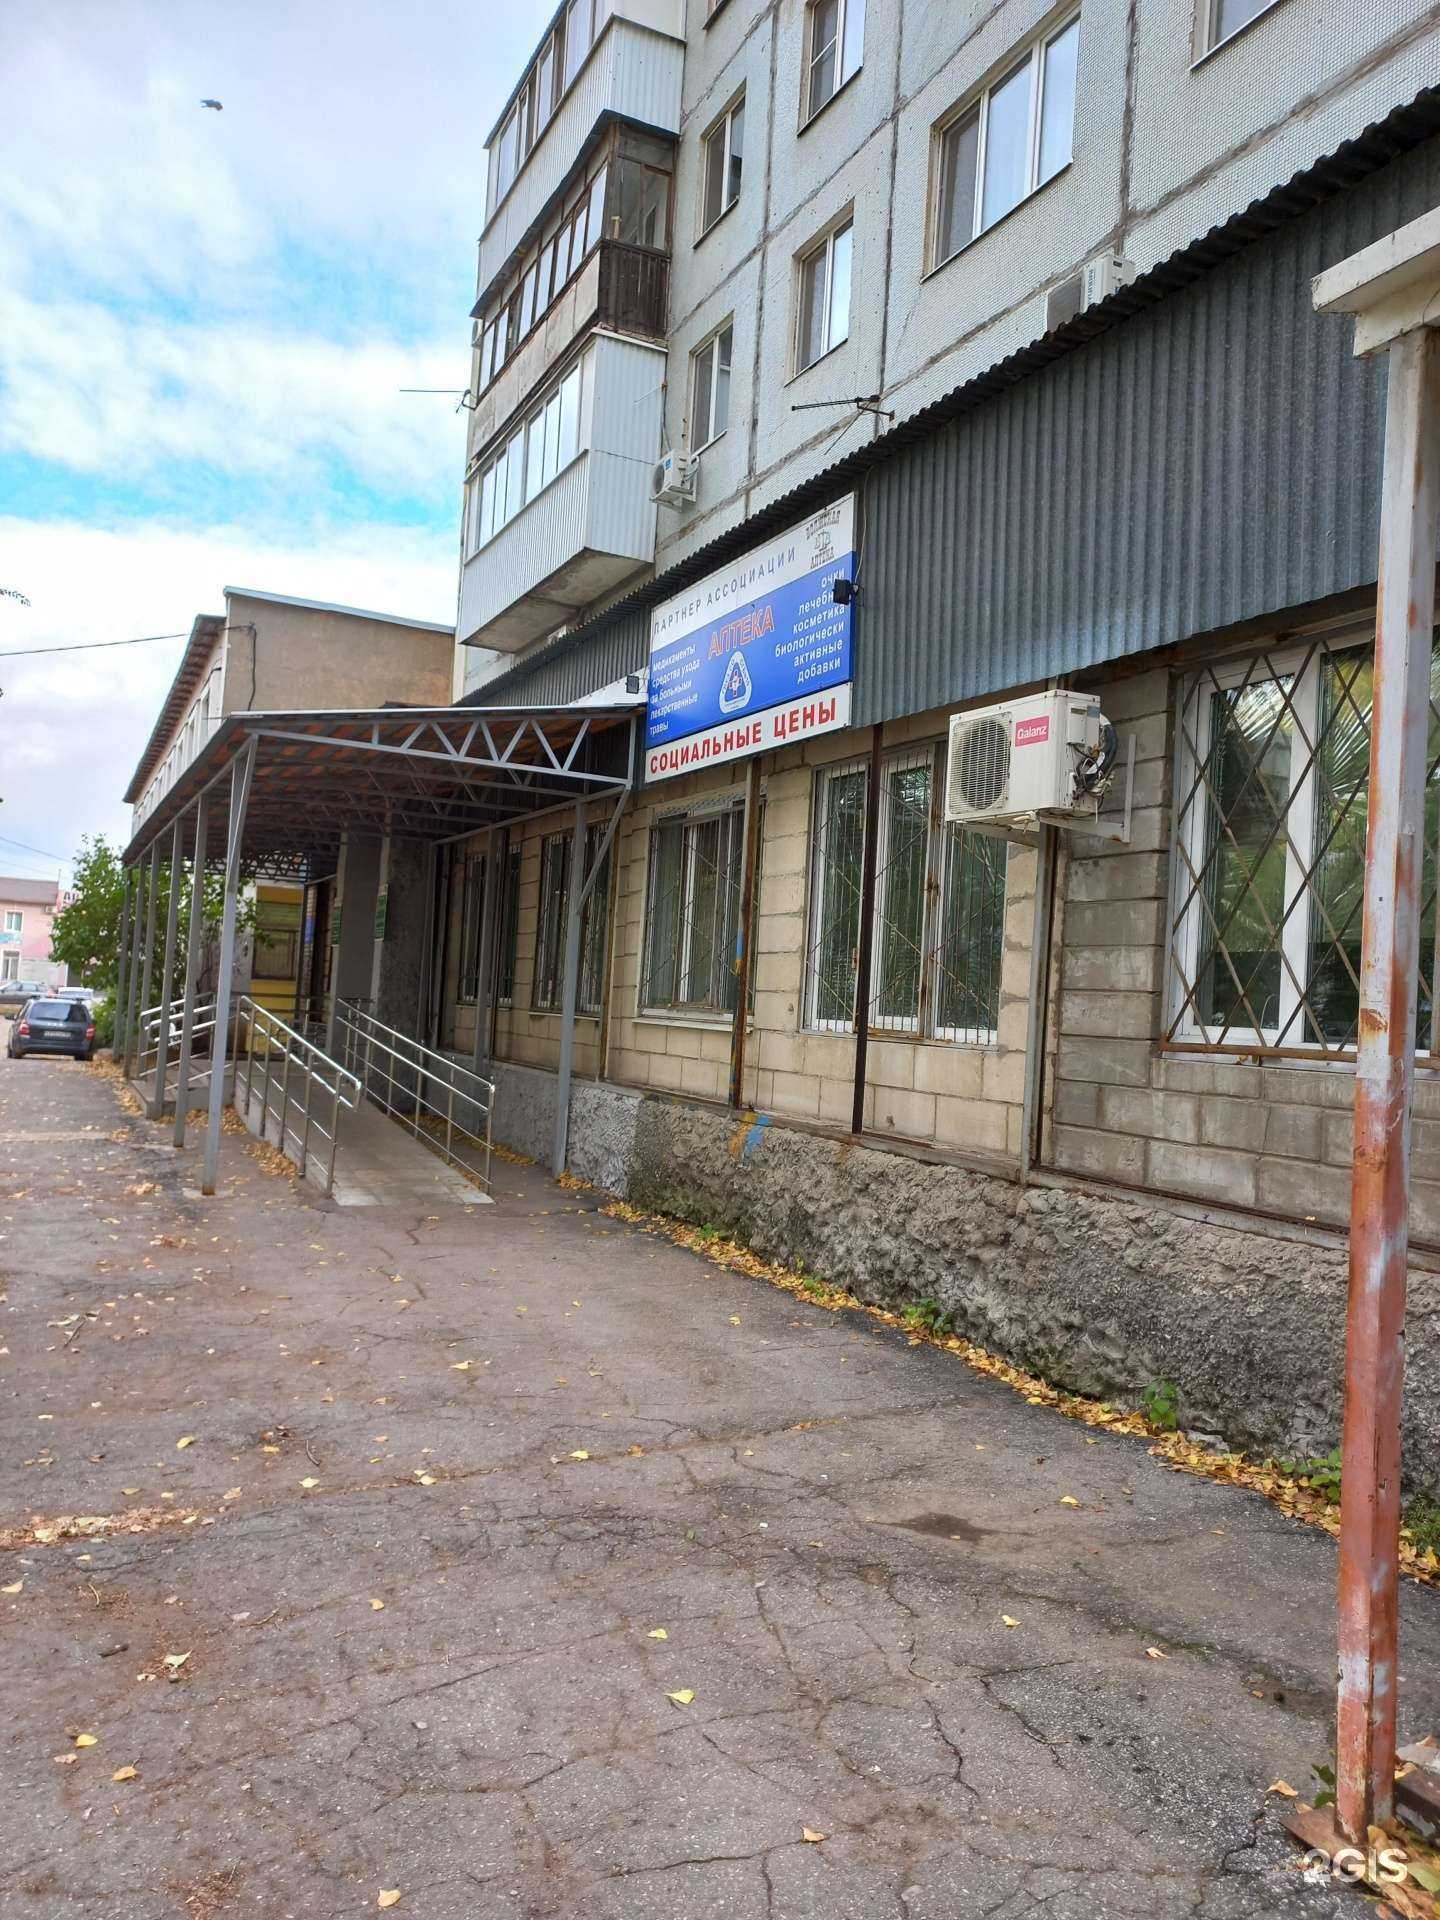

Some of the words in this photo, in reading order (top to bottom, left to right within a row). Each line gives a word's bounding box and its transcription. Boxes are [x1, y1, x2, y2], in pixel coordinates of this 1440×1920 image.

[811, 547, 835, 570] АПТЕКА
[654, 598, 701, 635] ПАРТНЕР
[707, 546, 795, 606] АССОЦИАЦИИ
[821, 568, 845, 588] очки
[799, 590, 834, 615] лечебн
[708, 604, 775, 660] АПТЕКА
[793, 604, 845, 634] косметика
[775, 621, 844, 657] биологически
[794, 639, 843, 667] активные
[653, 644, 696, 672] медикаменты
[797, 657, 841, 684] добавки
[652, 669, 680, 689] средства
[681, 659, 700, 678] ухода
[650, 720, 669, 738] травы
[650, 721, 762, 774] СОЦИАЛЬНЫЕ
[773, 697, 836, 740] ЦЕНЫ
[1017, 725, 1048, 740] Galanz
